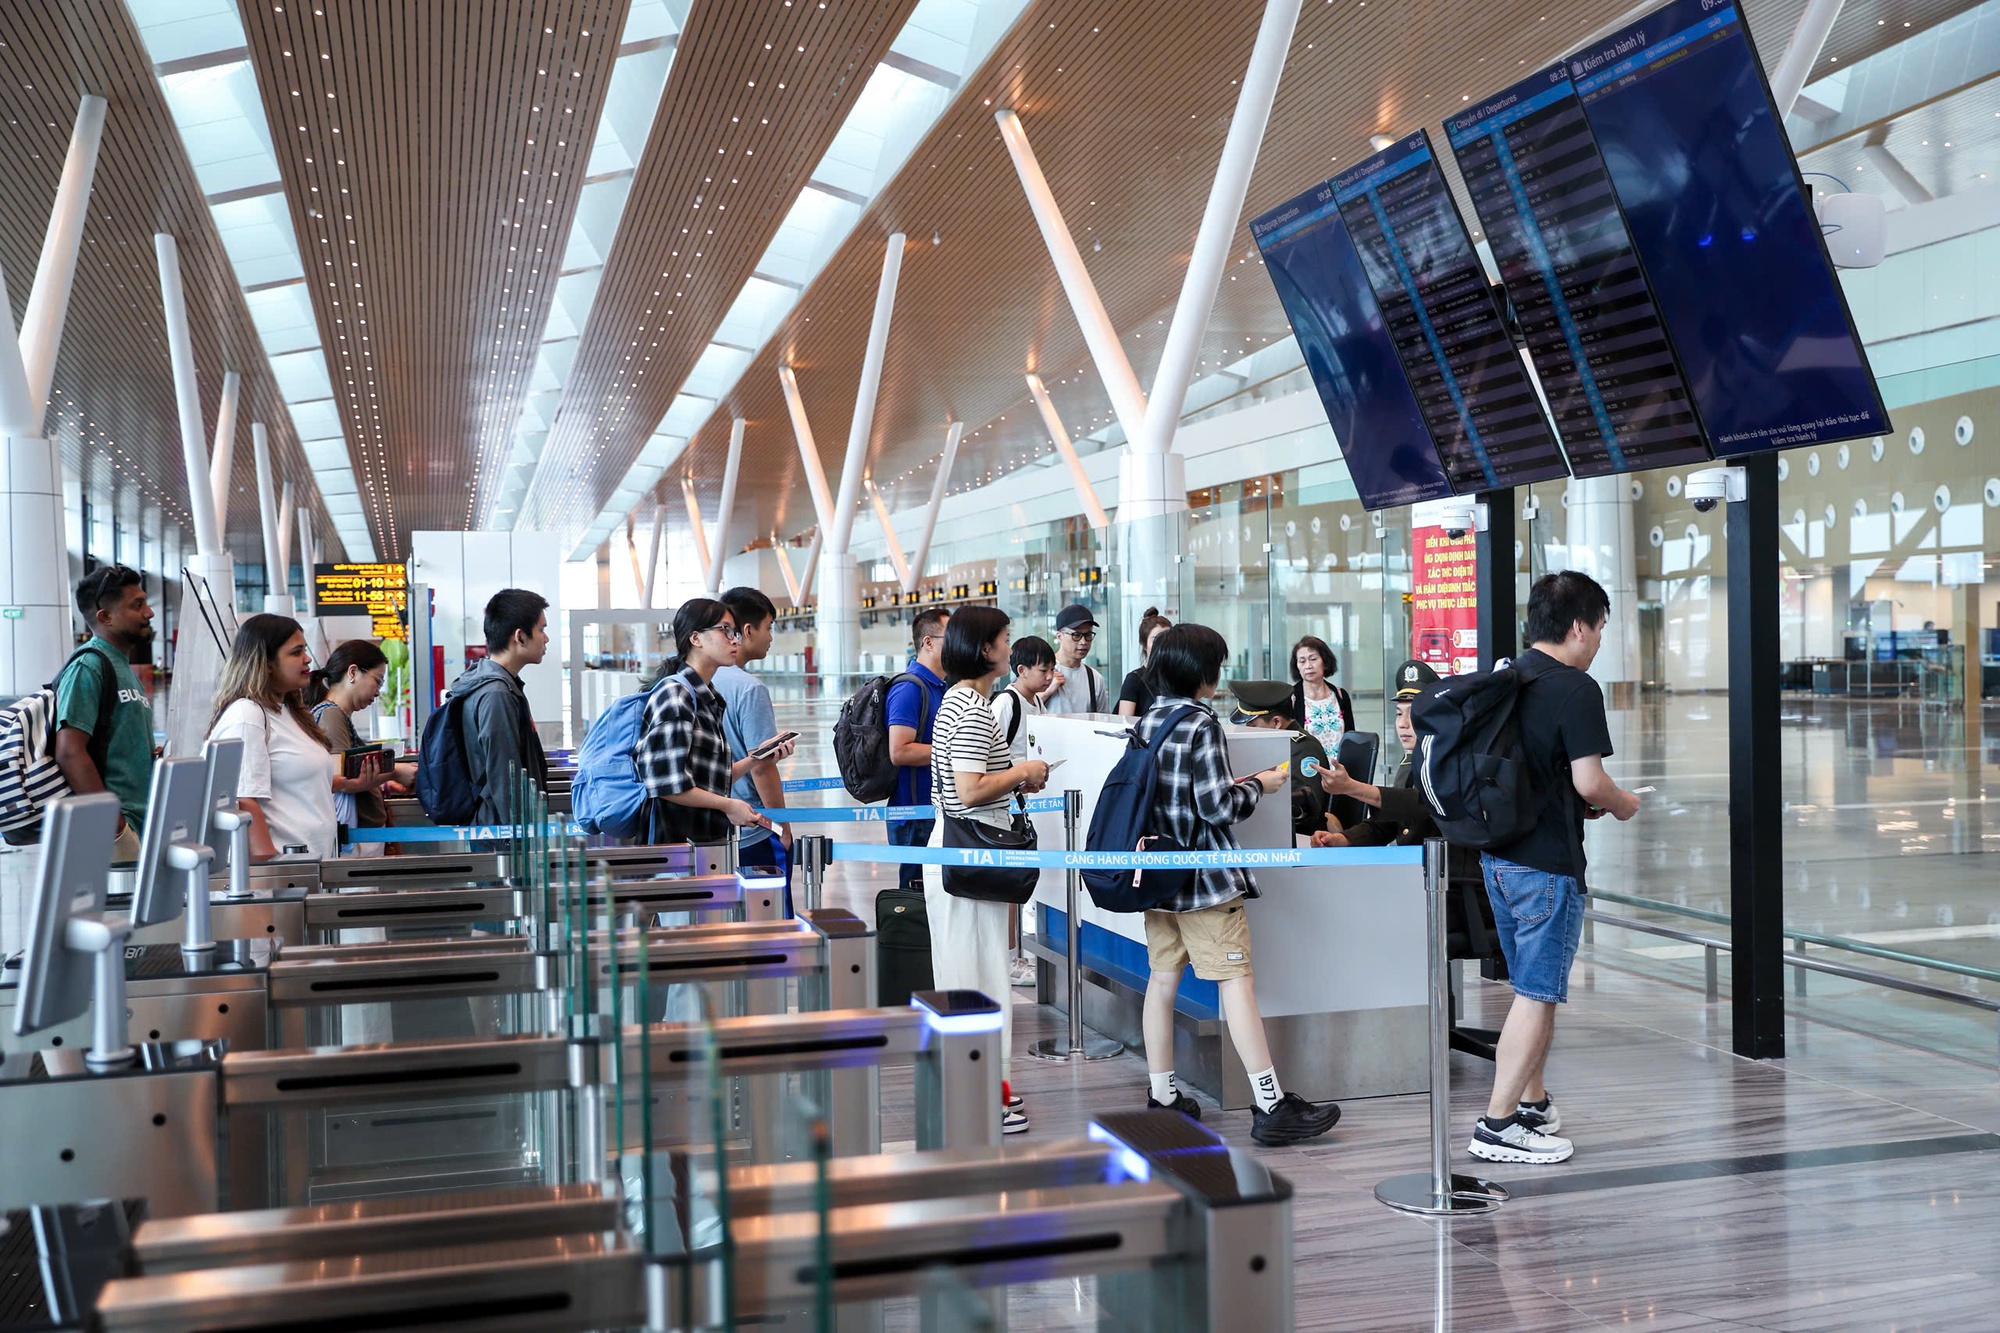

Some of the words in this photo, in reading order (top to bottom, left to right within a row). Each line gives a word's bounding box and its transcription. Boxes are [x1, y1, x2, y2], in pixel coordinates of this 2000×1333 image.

[1583, 55, 1604, 72] Kiểm
[1604, 49, 1616, 61] tra
[1615, 36, 1638, 55] hành
[1636, 30, 1646, 46] lý
[1549, 67, 1568, 83] 09:32
[1485, 94, 1517, 114] Departures
[1409, 137, 1424, 150] 09:32
[1361, 159, 1386, 177] Departures
[1317, 189, 1332, 202] 09:32
[1260, 218, 1278, 233] Baggage
[1277, 206, 1300, 225] Inspection
[1718, 435, 1734, 444] Hành
[1733, 432, 1751, 442] khách
[1750, 430, 1758, 438] có
[1758, 428, 1768, 437] tên
[1768, 428, 1778, 436] xin
[1778, 425, 1787, 435] vui
[1787, 423, 1801, 434] lòng
[1801, 420, 1817, 431] quay
[1817, 418, 1825, 429] lại
[1837, 414, 1849, 424] thủ
[1849, 412, 1860, 423] tục
[1860, 410, 1870, 420] để
[1770, 435, 1787, 446] kiểm
[1787, 434, 1796, 443] tra
[1796, 432, 1811, 442] hành
[1811, 430, 1818, 441] lý
[1427, 566, 1441, 578] XÁC
[352, 577, 384, 588] 01-10
[1457, 596, 1468, 609] LÊN
[1014, 800, 1036, 811] QỐC
[1048, 798, 1064, 808] TÂN
[852, 808, 880, 821] TIA
[453, 828, 495, 840] TIA
[959, 849, 994, 865] TIA
[1064, 851, 1095, 865] CẢNG
[1097, 851, 1128, 865] HÀNG
[1131, 852, 1170, 865] KHÔNG
[1172, 851, 1203, 866] QUỐC
[1205, 850, 1219, 864] TẾ
[1220, 851, 1243, 864] TÂN
[1245, 851, 1268, 863] SƠN
[1271, 849, 1302, 863] NHẤT
[1258, 1073, 1277, 1101] 1977
